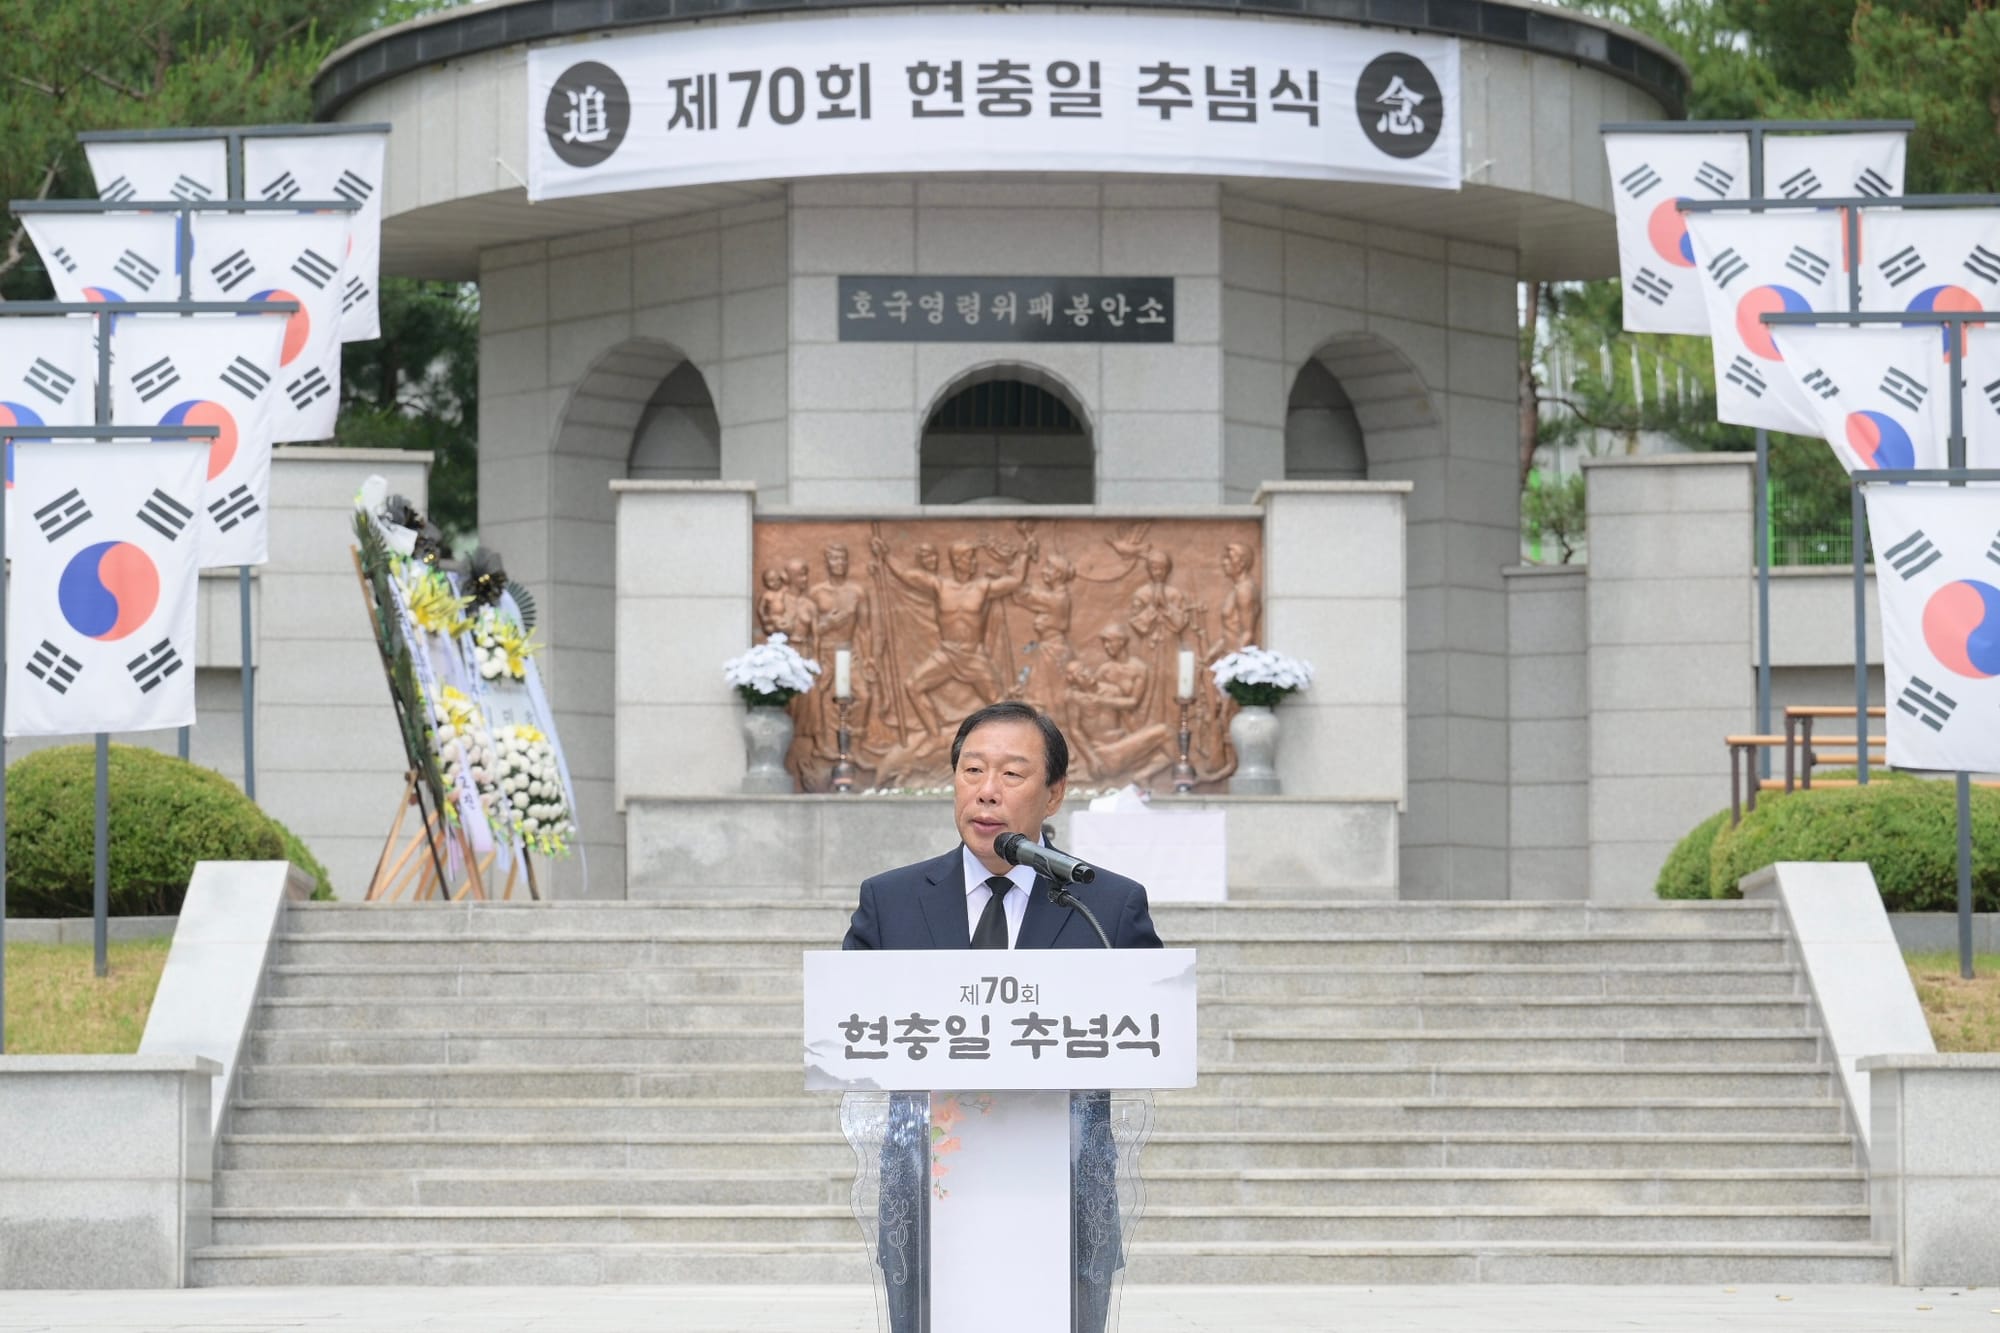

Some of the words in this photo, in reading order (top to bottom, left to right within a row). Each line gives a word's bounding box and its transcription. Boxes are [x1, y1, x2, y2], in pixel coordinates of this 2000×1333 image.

[563, 87, 609, 144] 追
[668, 63, 871, 131] 제70회
[905, 59, 1102, 118] 현충일
[1138, 62, 1319, 127] 추념식
[1376, 75, 1424, 135] 念
[846, 290, 1166, 326] 호국영령위패봉안소
[960, 976, 1039, 1005] 제70회
[838, 1012, 991, 1061] 현충일
[1011, 1011, 1162, 1061] 추념식
